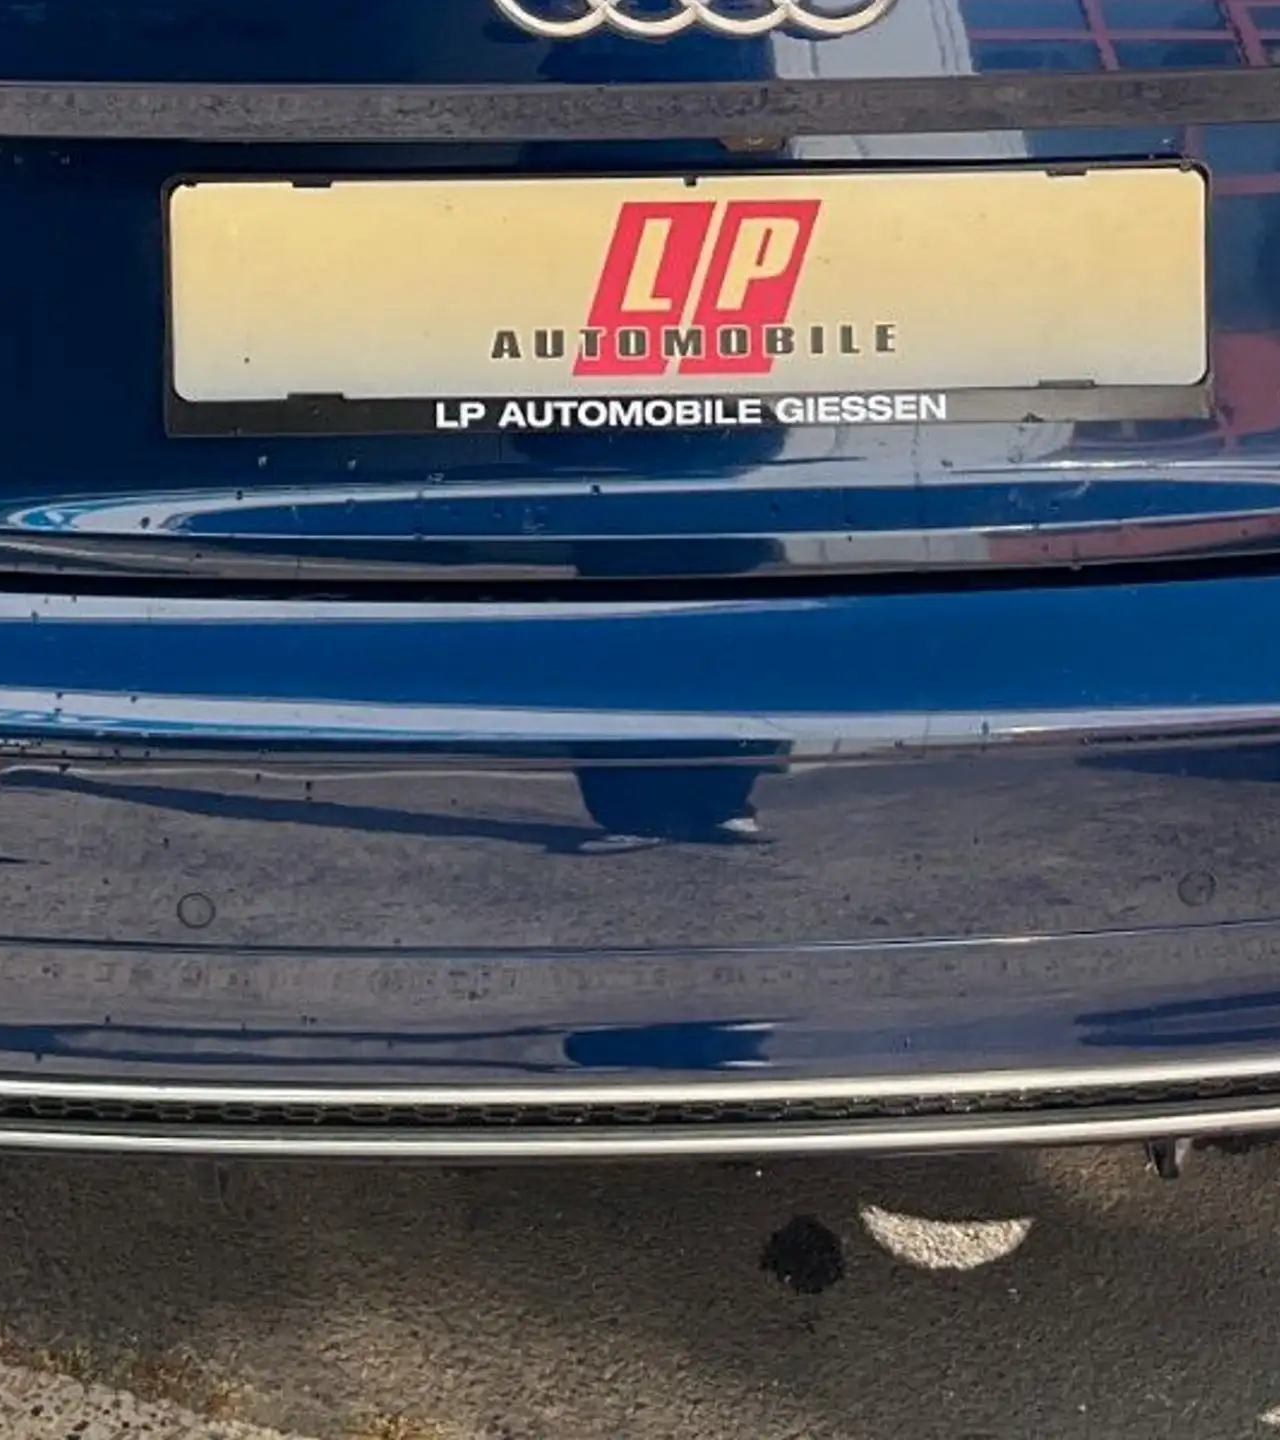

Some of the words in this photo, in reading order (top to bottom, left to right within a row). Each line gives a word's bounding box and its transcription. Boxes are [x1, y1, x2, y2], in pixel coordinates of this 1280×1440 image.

[622, 217, 800, 311] LP
[491, 324, 896, 359] AUTOMOBILE
[435, 400, 486, 430] LP
[499, 398, 761, 428] AUTOMOBILE
[775, 393, 947, 424] GIESSEN
